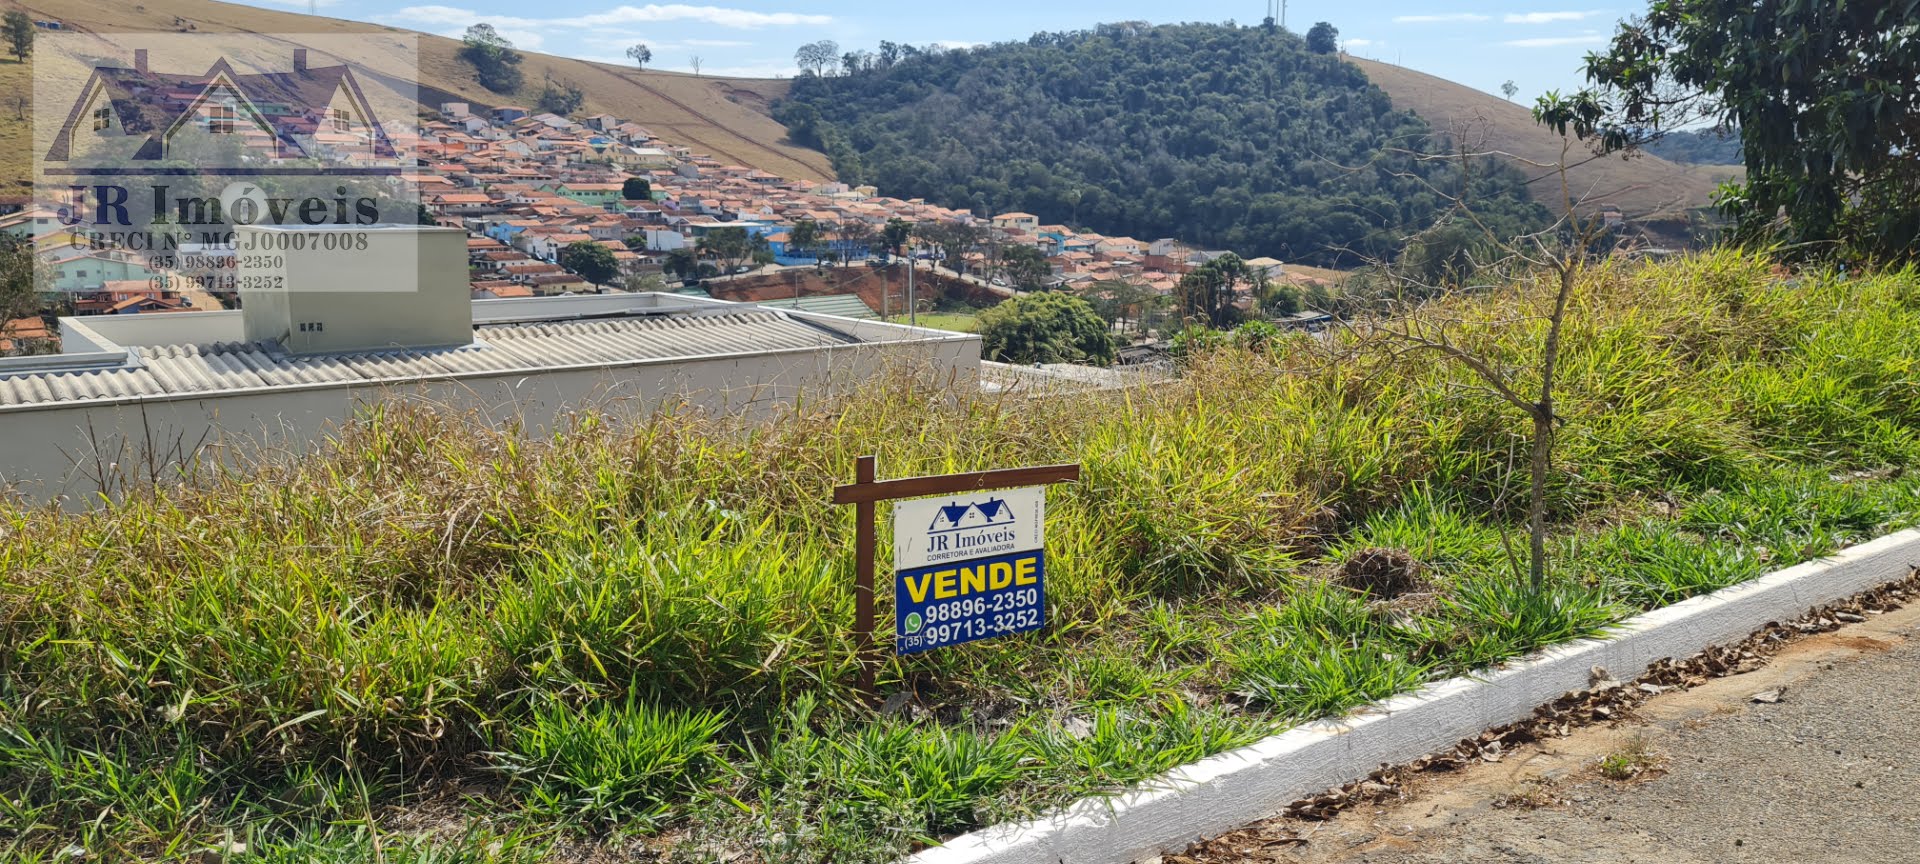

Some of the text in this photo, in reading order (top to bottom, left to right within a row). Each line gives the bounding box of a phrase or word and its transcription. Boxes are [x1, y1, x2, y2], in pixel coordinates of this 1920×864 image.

[927, 526, 1015, 553] JR Imóveis
[927, 550, 968, 562] CORRETORA
[974, 543, 1015, 555] AVALIADORA
[903, 556, 1037, 604] VENDE
[926, 588, 1038, 624] 98896-2350
[904, 609, 1038, 649] (35) 99713-3252
